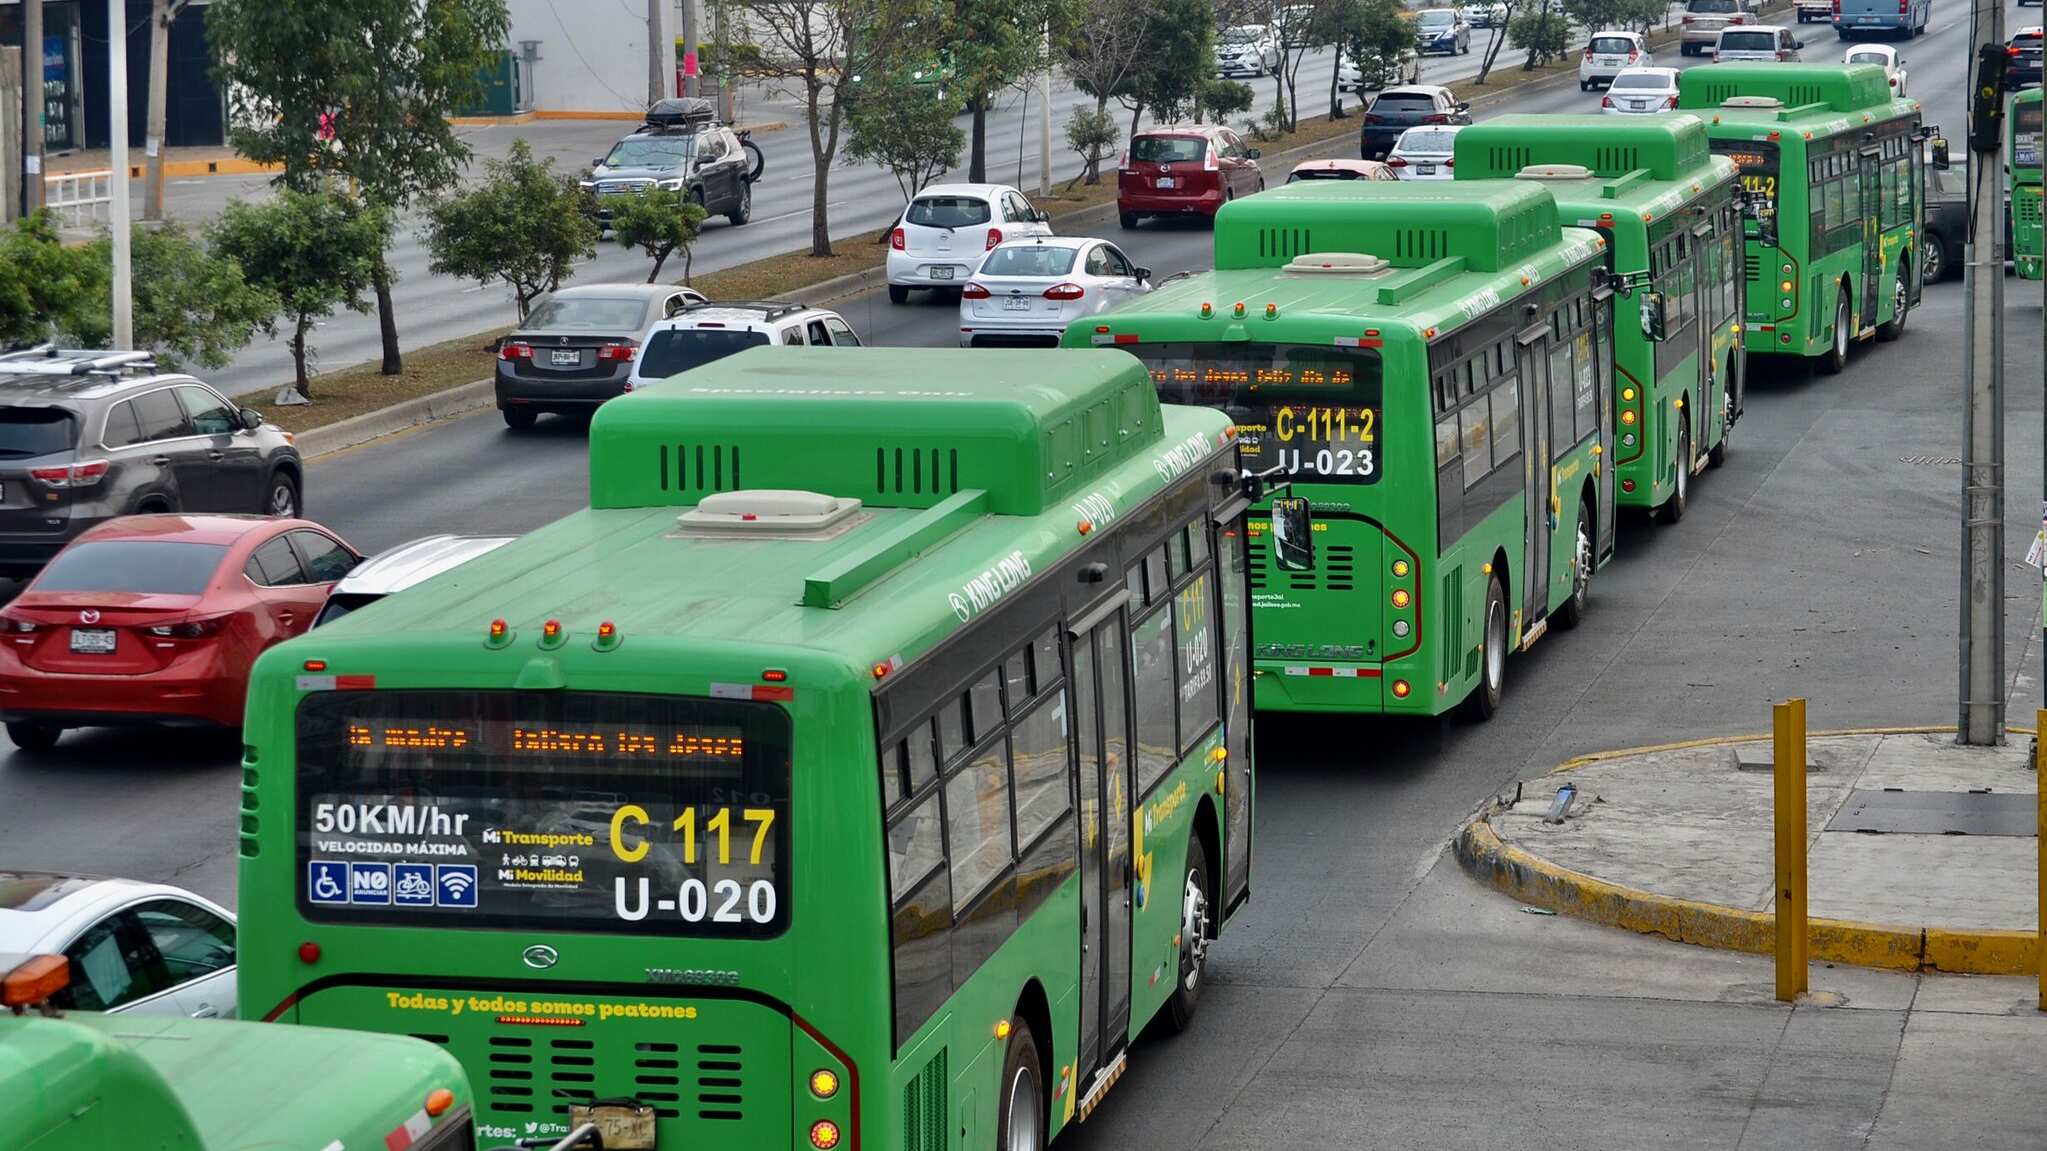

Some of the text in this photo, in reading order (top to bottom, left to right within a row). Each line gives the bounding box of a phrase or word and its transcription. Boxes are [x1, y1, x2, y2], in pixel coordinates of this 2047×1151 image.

[1276, 406, 1374, 443] C-111-2
[1278, 448, 1375, 476] U-023
[962, 550, 1032, 613] KING LONG
[315, 803, 469, 837] 50KM/hr
[609, 805, 775, 865] C 117
[318, 839, 468, 856] VELOCIDAD MÁXIMA
[482, 828, 594, 848] Mi Transporte
[498, 869, 583, 882] Mi Movilidad
[614, 876, 777, 924] U-020
[387, 993, 698, 1020] Todas y todos somos peatones
